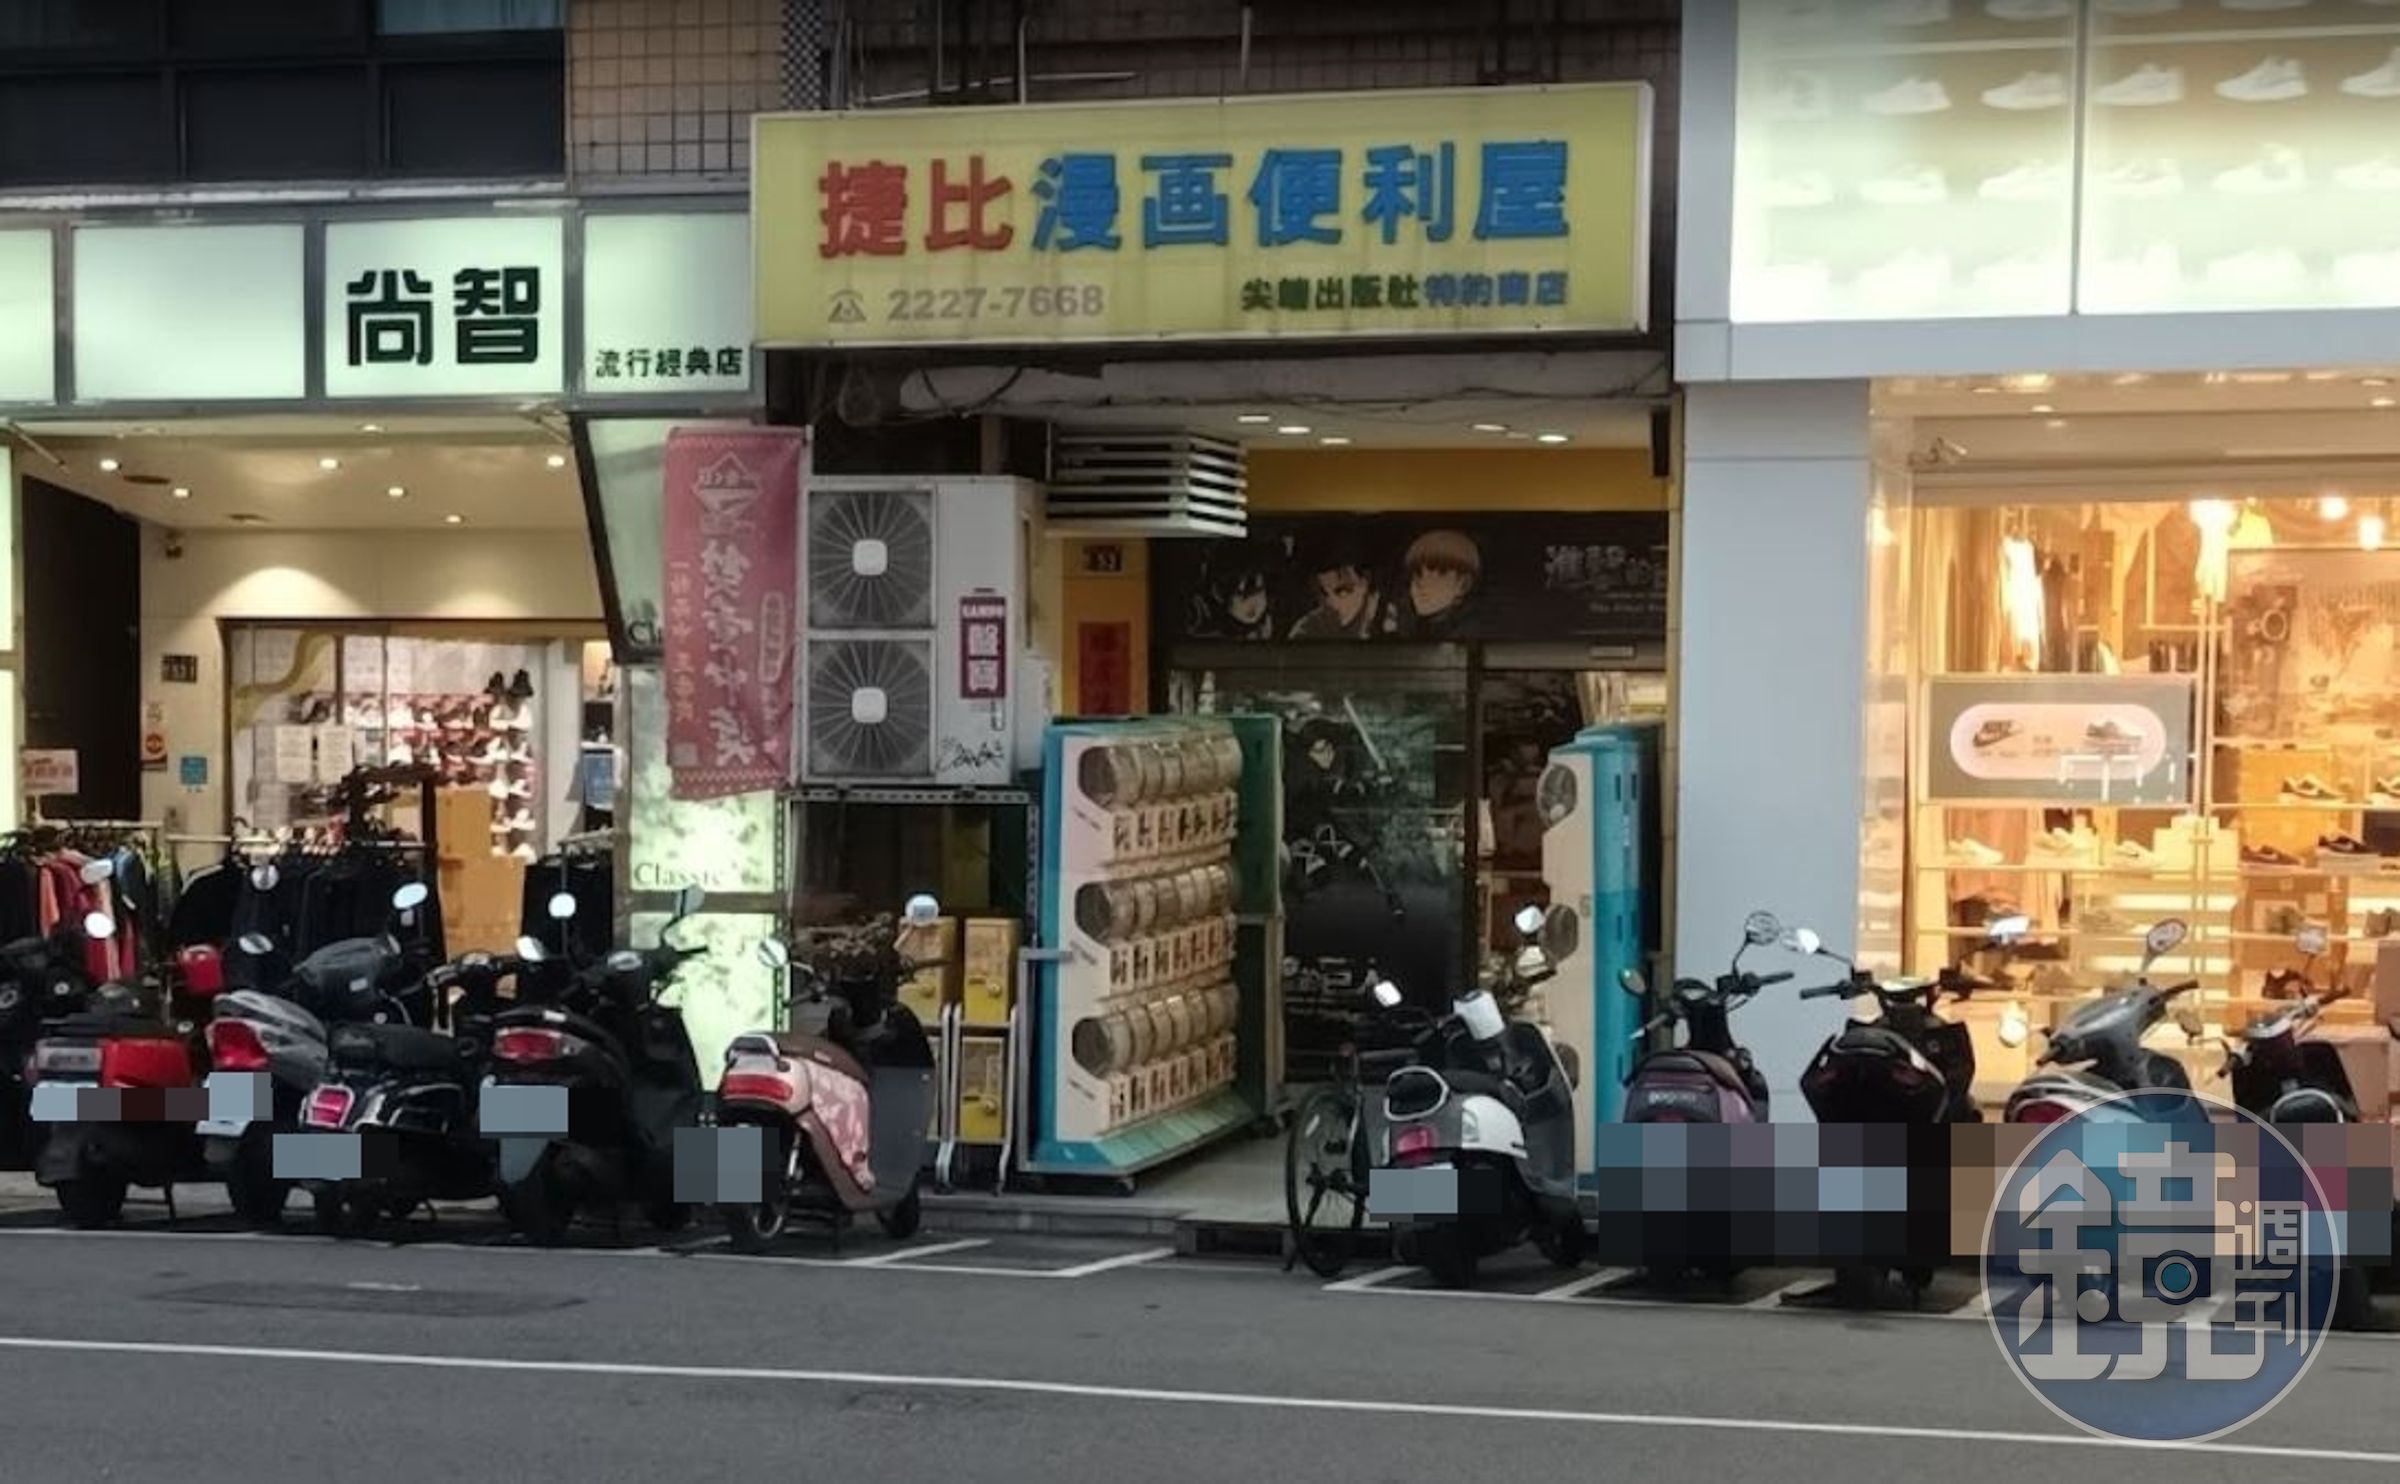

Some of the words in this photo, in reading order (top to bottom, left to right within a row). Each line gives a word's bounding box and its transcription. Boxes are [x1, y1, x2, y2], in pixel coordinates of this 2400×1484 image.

[347, 267, 541, 367] 尚智
[888, 284, 1105, 322] 2227-7668
[596, 346, 744, 378] 流行經典店
